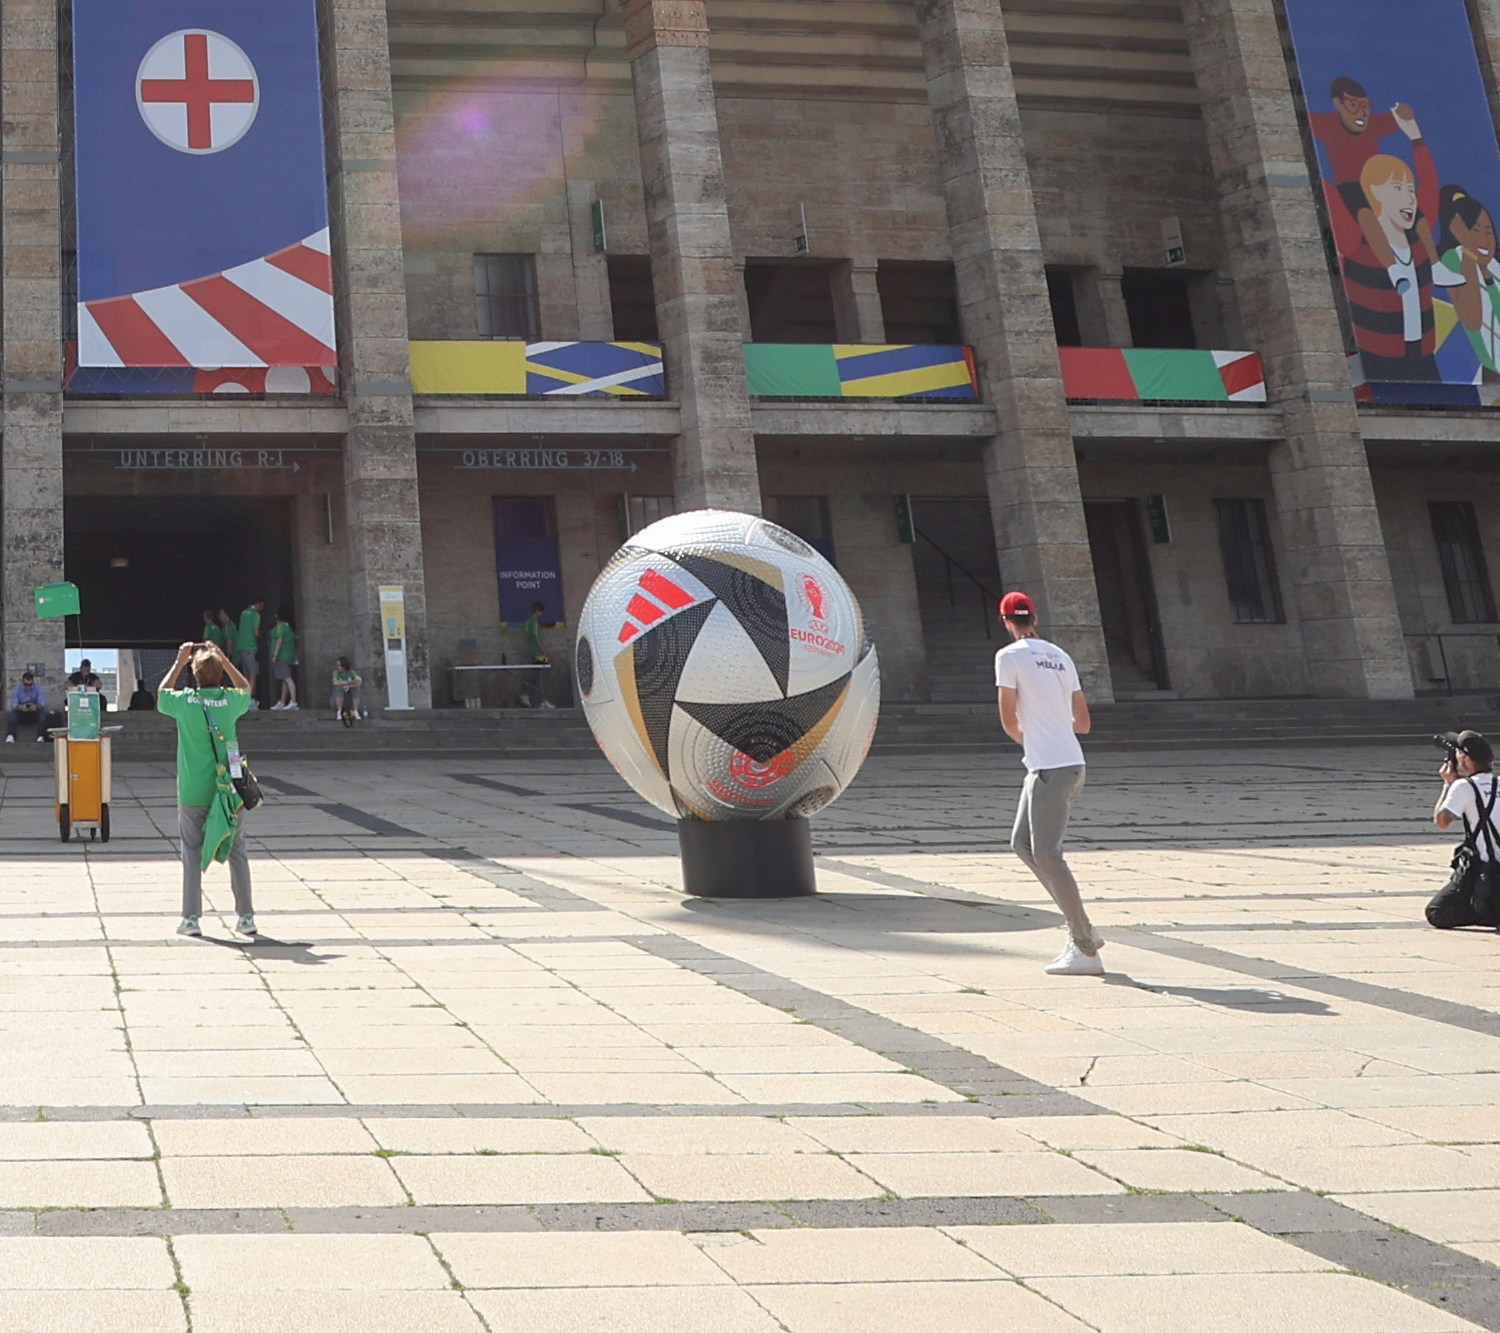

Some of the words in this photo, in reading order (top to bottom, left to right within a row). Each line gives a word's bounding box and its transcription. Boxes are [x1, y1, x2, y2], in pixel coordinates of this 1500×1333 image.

[120, 450, 243, 467] UNTERRING
[258, 450, 284, 467] R-J
[462, 451, 569, 468] OBERRING
[583, 450, 625, 467] 37-18
[499, 571, 556, 580] INFORMATION
[515, 581, 541, 589] POINT
